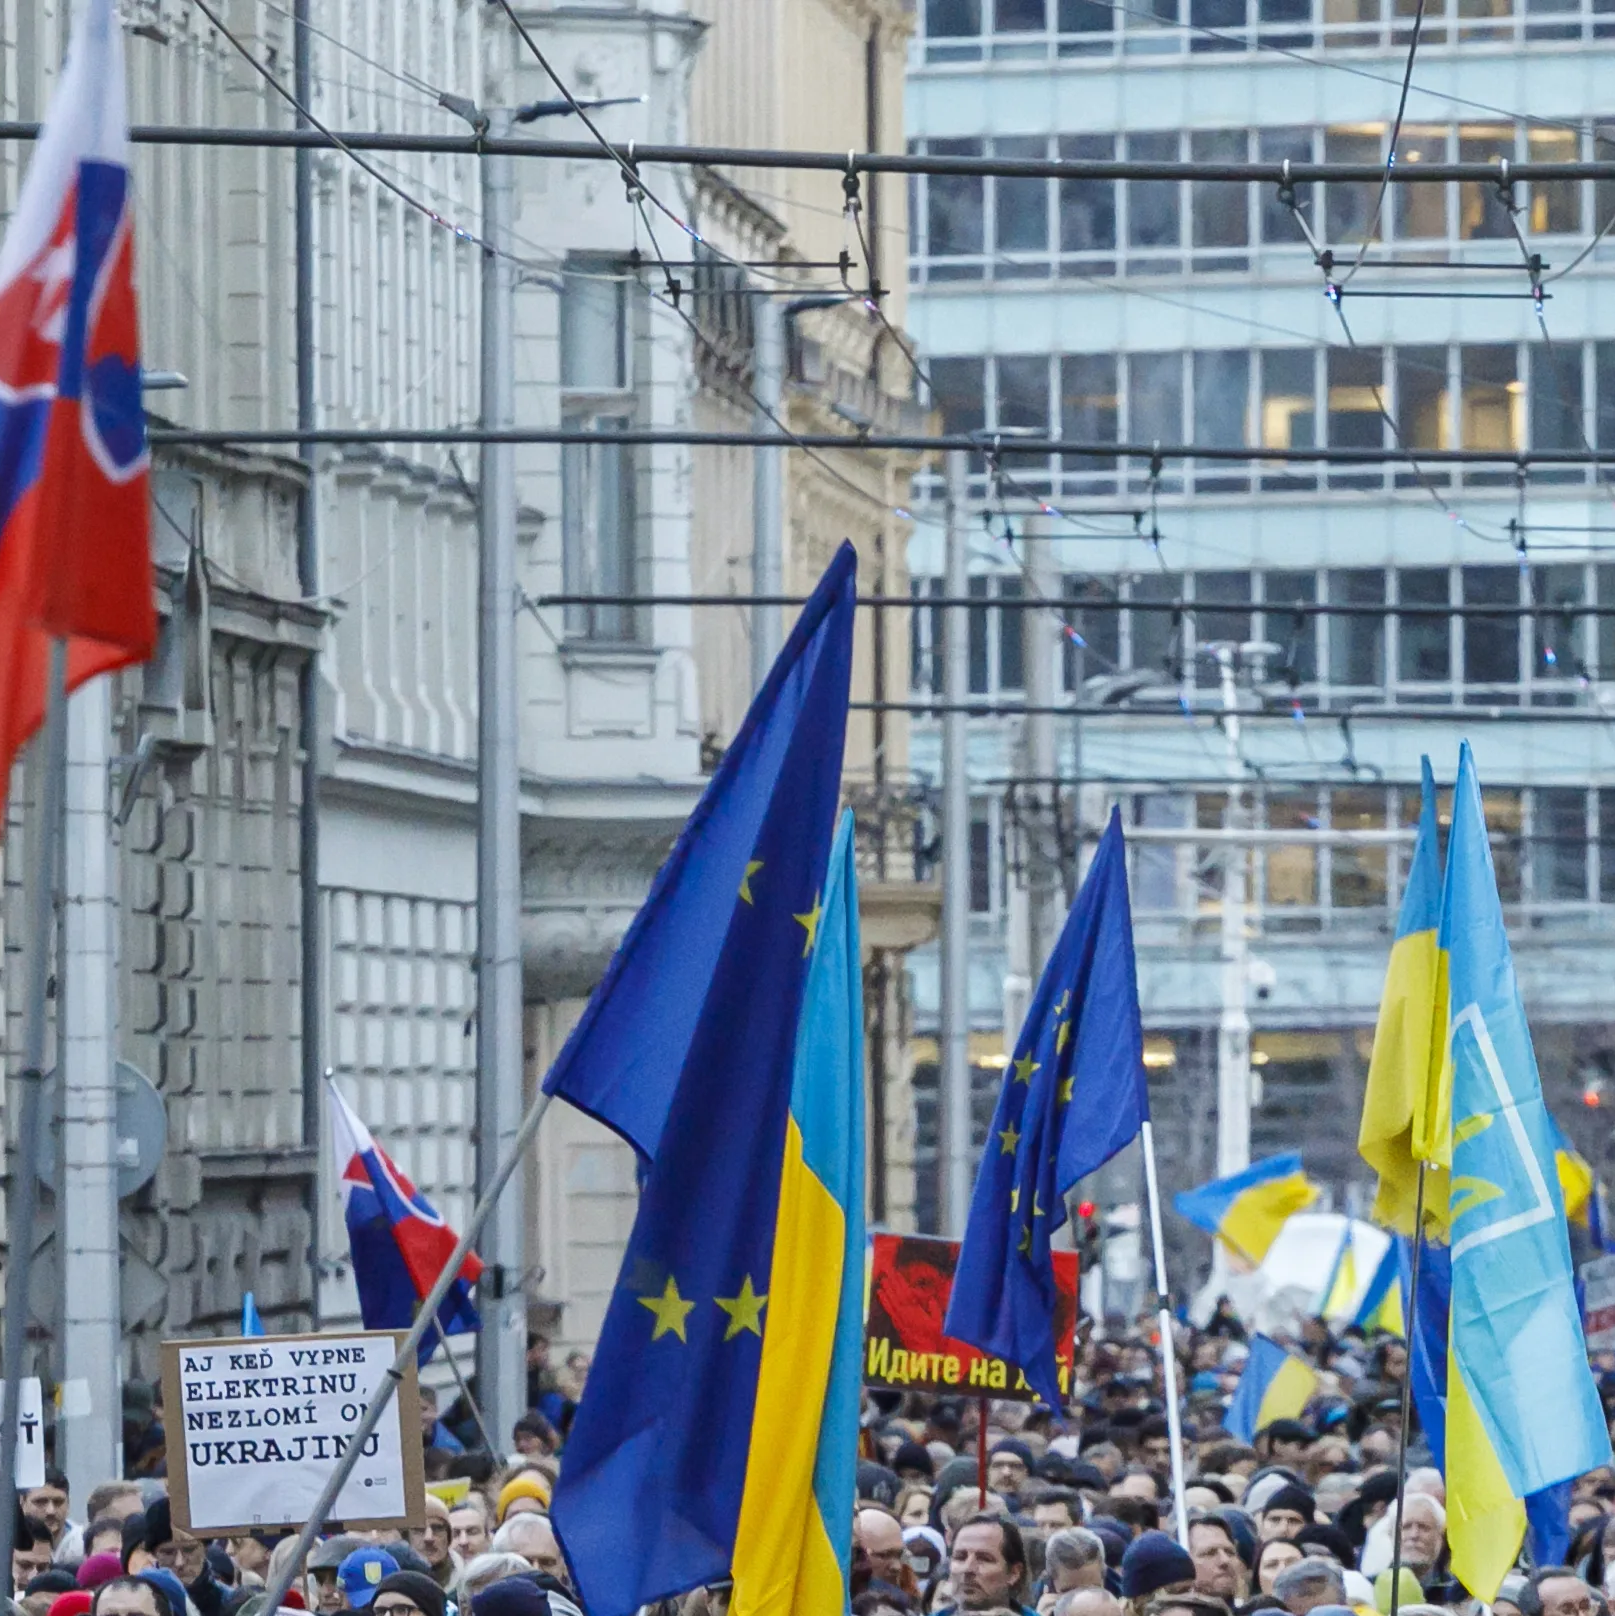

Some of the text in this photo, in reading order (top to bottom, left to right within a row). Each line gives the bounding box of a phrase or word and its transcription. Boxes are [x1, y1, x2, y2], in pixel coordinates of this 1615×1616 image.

[184, 1347, 366, 1373] AJ KEĎ VYPNE
[868, 1336, 1069, 1404] Идите на хй
[185, 1373, 368, 1402] ELEKTRINU,
[187, 1399, 318, 1431] NEZLOMÍ
[189, 1433, 380, 1467] UKRAJINU
